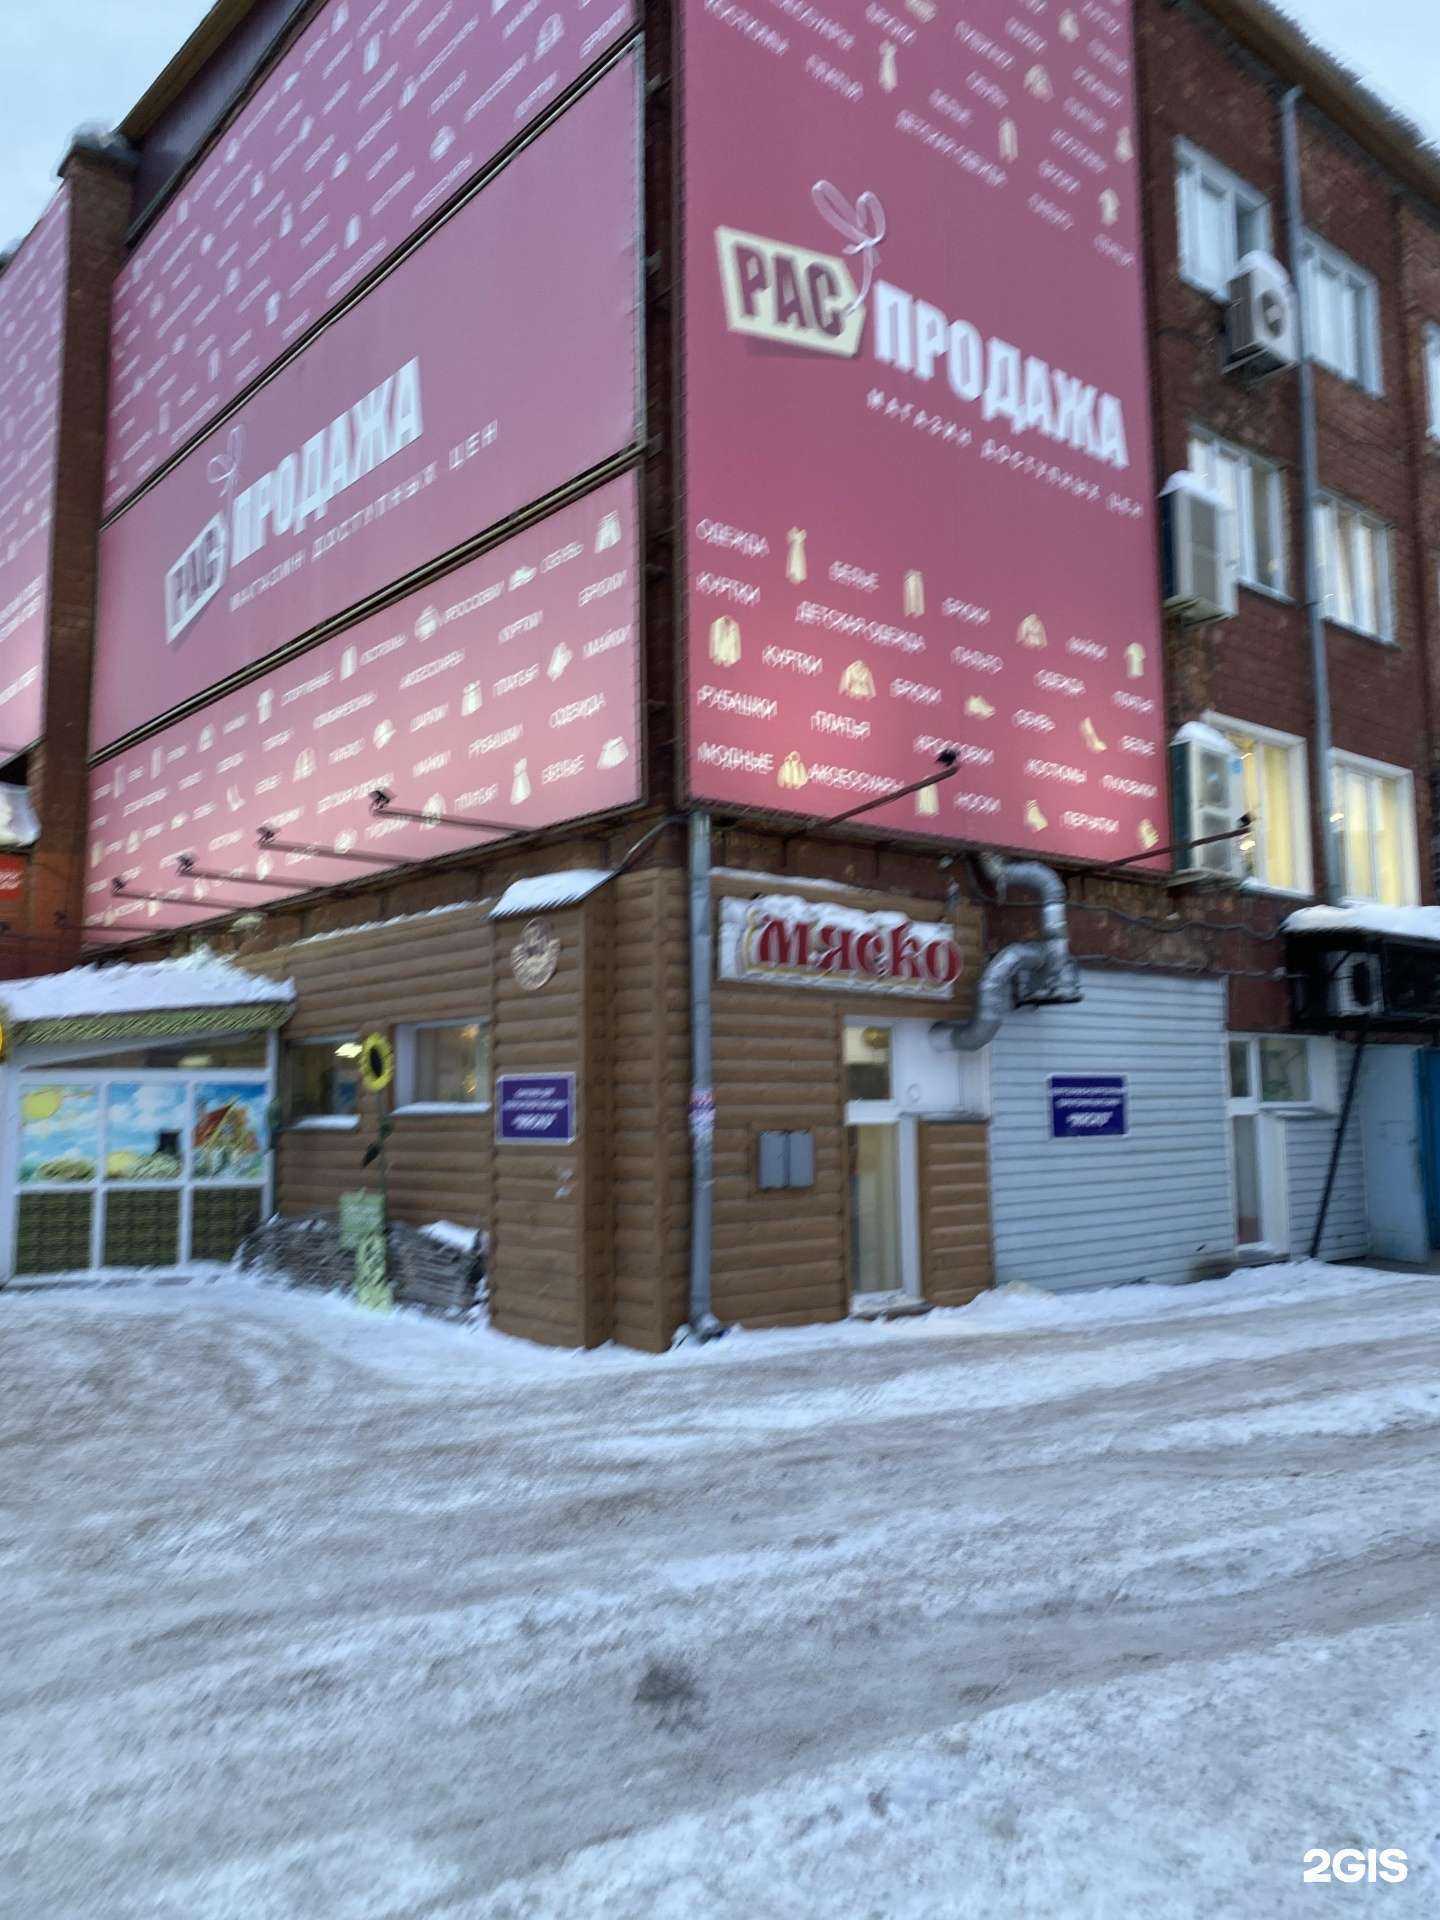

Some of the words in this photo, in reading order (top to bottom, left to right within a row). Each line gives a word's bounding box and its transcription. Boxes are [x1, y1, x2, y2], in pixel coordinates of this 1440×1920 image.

[231, 355, 424, 568] ПРОДАЖА
[733, 240, 847, 338] РАС
[873, 281, 1128, 469] ПРОДАЖА
